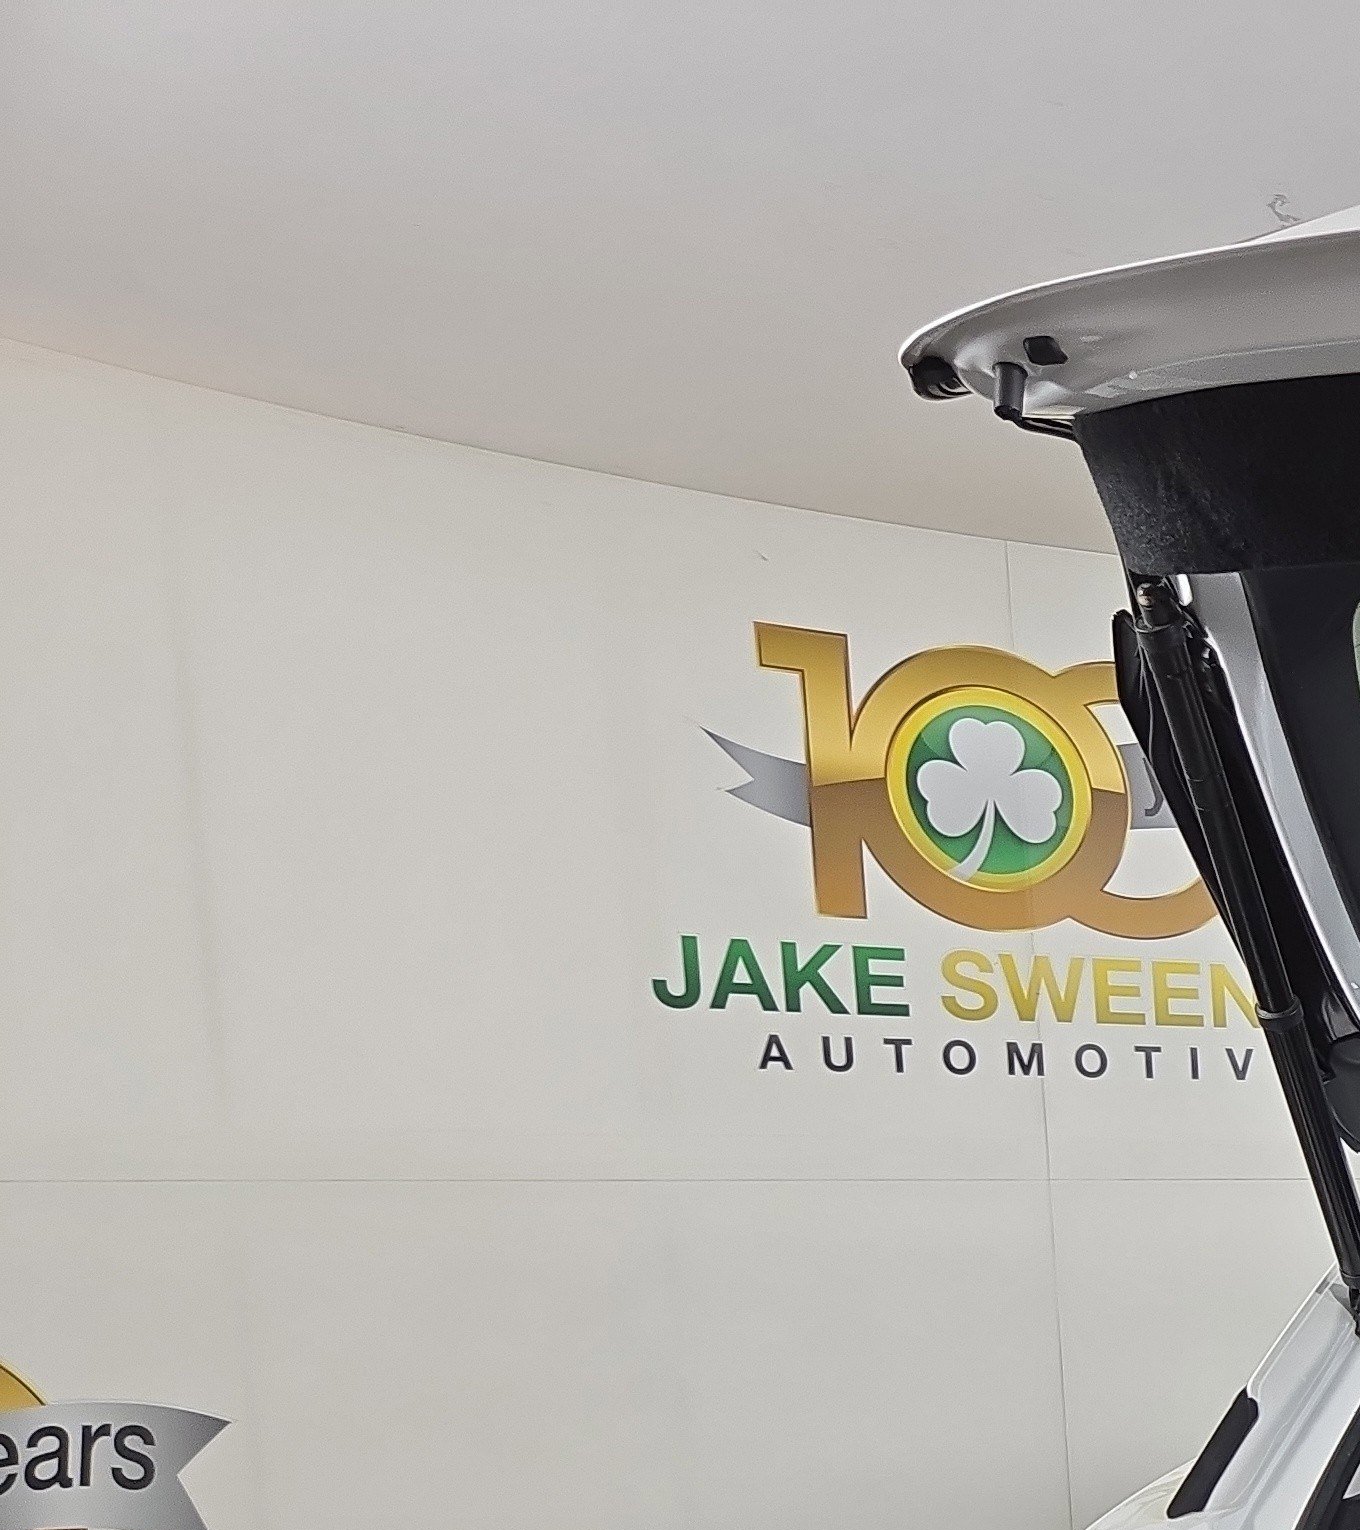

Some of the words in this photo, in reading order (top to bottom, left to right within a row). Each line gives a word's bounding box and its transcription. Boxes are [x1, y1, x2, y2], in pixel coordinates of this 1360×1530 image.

[651, 934, 911, 1017] JAKE
[940, 949, 1262, 1030] SWEEN
[757, 1033, 1256, 1082] AUTOMOTIV
